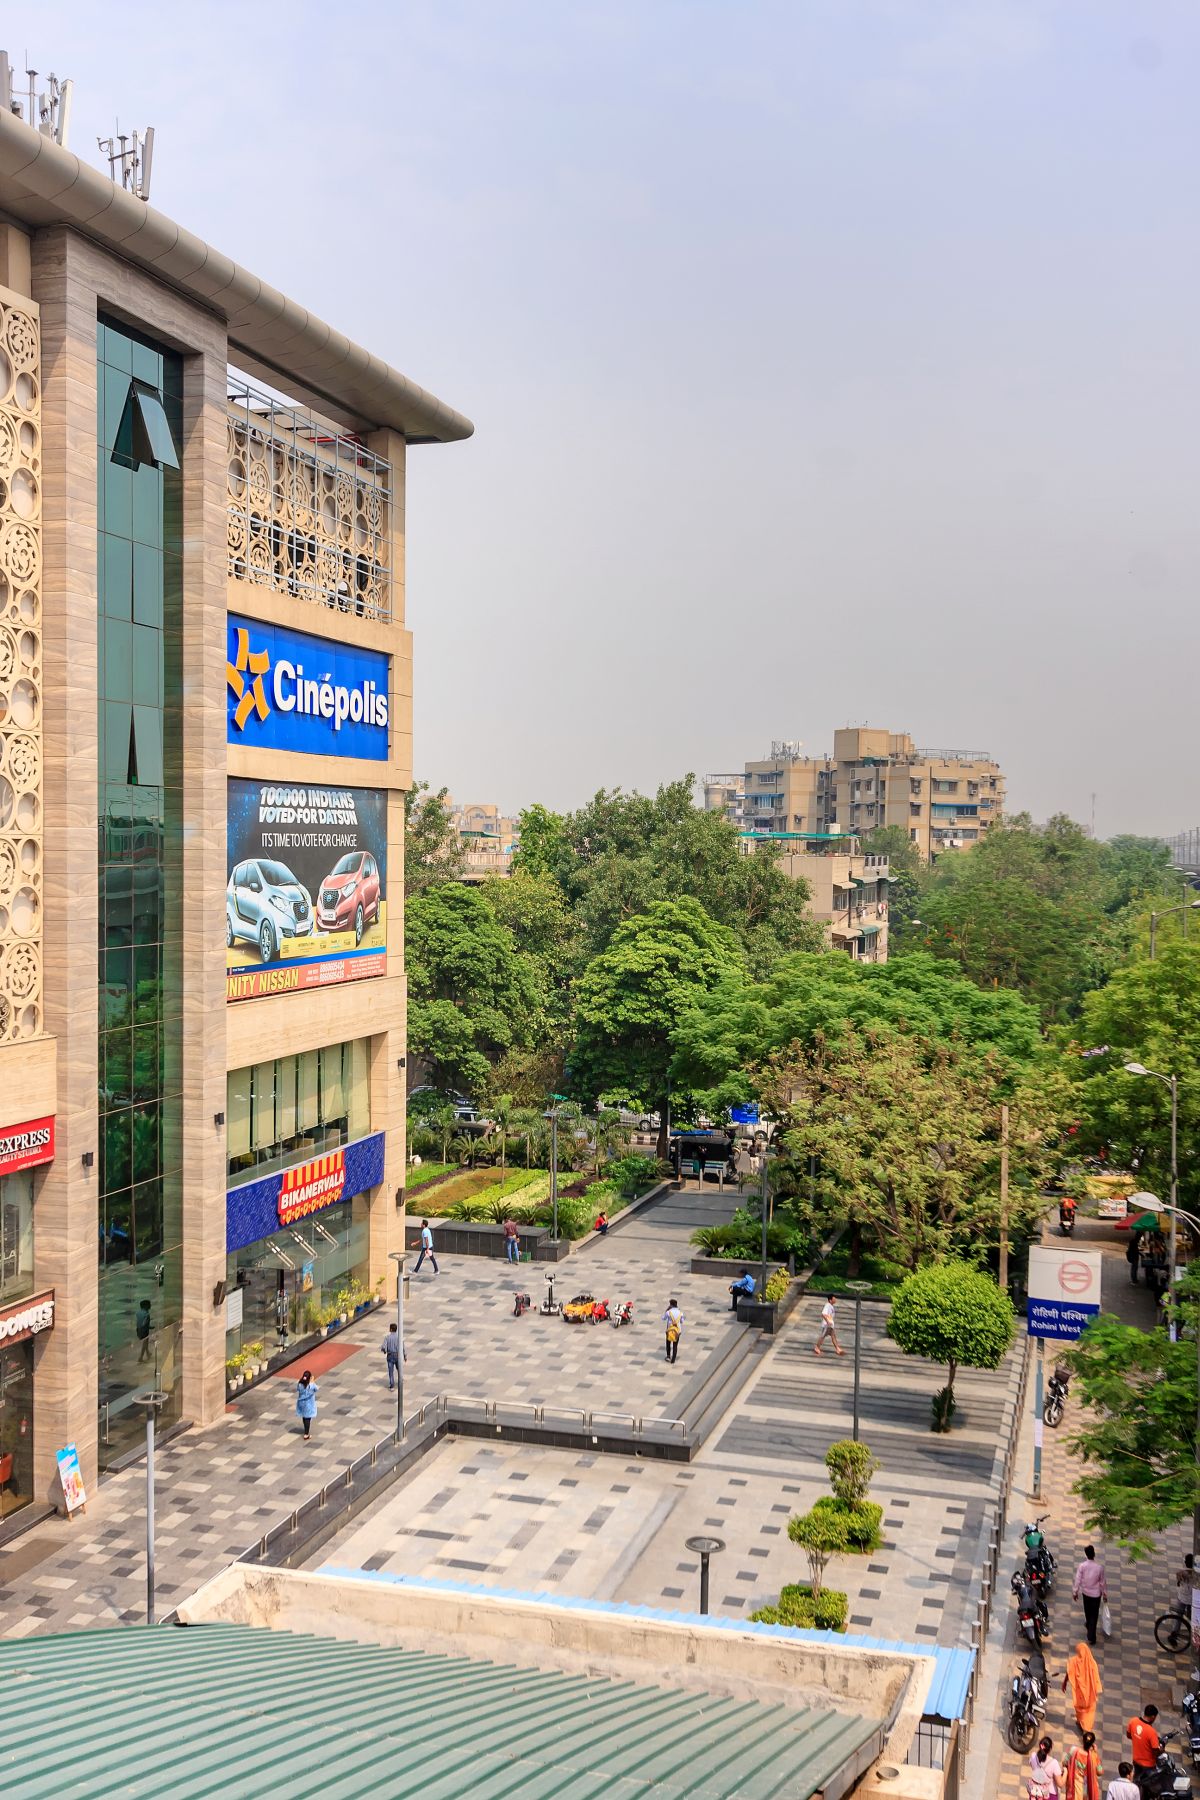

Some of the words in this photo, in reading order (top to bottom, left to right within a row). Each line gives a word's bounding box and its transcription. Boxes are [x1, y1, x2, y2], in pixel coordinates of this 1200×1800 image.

[274, 659, 388, 731] Cinépolis
[260, 786, 307, 808] 100000
[308, 789, 355, 809] INDIANS
[259, 806, 297, 823] VOTED
[297, 808, 318, 824] FOR
[318, 809, 358, 825] DATSUN
[272, 833, 291, 847] TIME
[291, 833, 300, 847] TO
[300, 833, 318, 848] VOTE
[318, 833, 332, 847] FOR
[331, 833, 357, 847] CHANGE
[258, 968, 299, 992] NISSAN
[281, 1170, 344, 1209] BIKANERVALA
[1032, 1306, 1059, 1319] रोहिणी
[1031, 1320, 1057, 1331] Rohini
[1059, 1323, 1081, 1333] West
